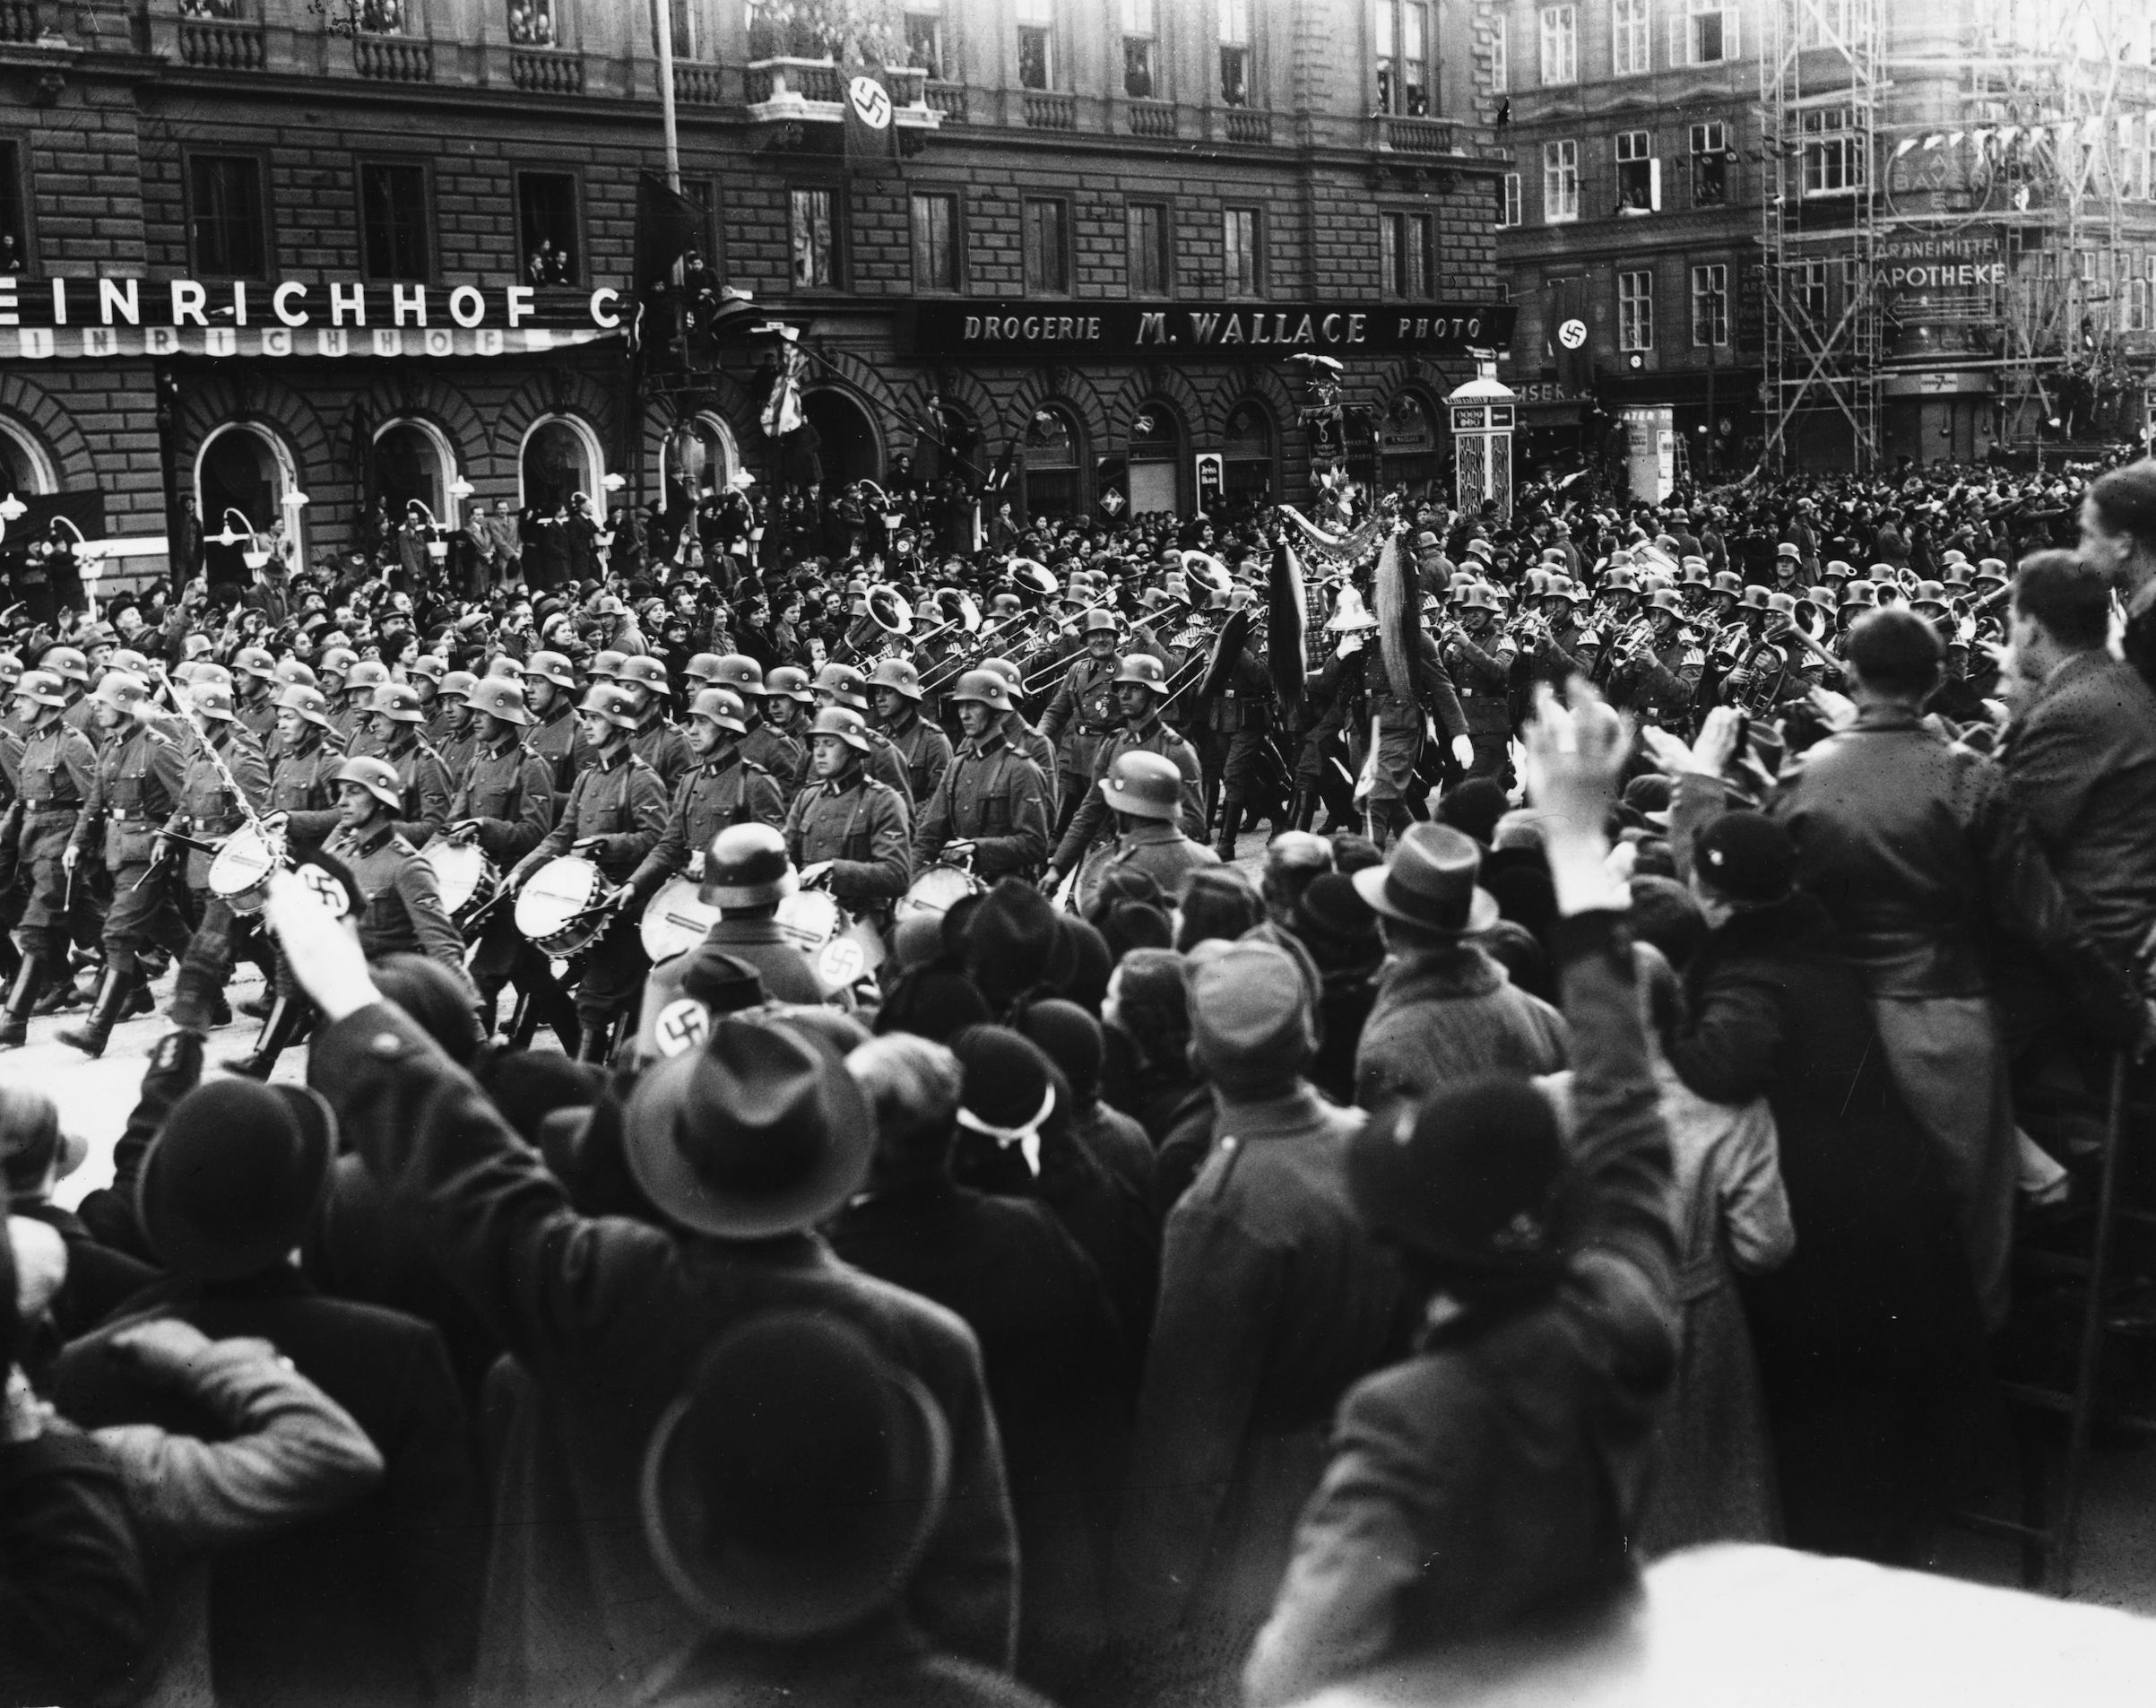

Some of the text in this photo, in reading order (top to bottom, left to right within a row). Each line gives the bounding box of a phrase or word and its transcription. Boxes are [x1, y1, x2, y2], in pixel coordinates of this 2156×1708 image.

[1873, 263, 2005, 289] APOTHEKE
[964, 312, 1480, 344] DROGERIE M. WALLACE PHOTO
[33, 329, 496, 356] INRICHHOF
[1935, 375, 1945, 391] 7
